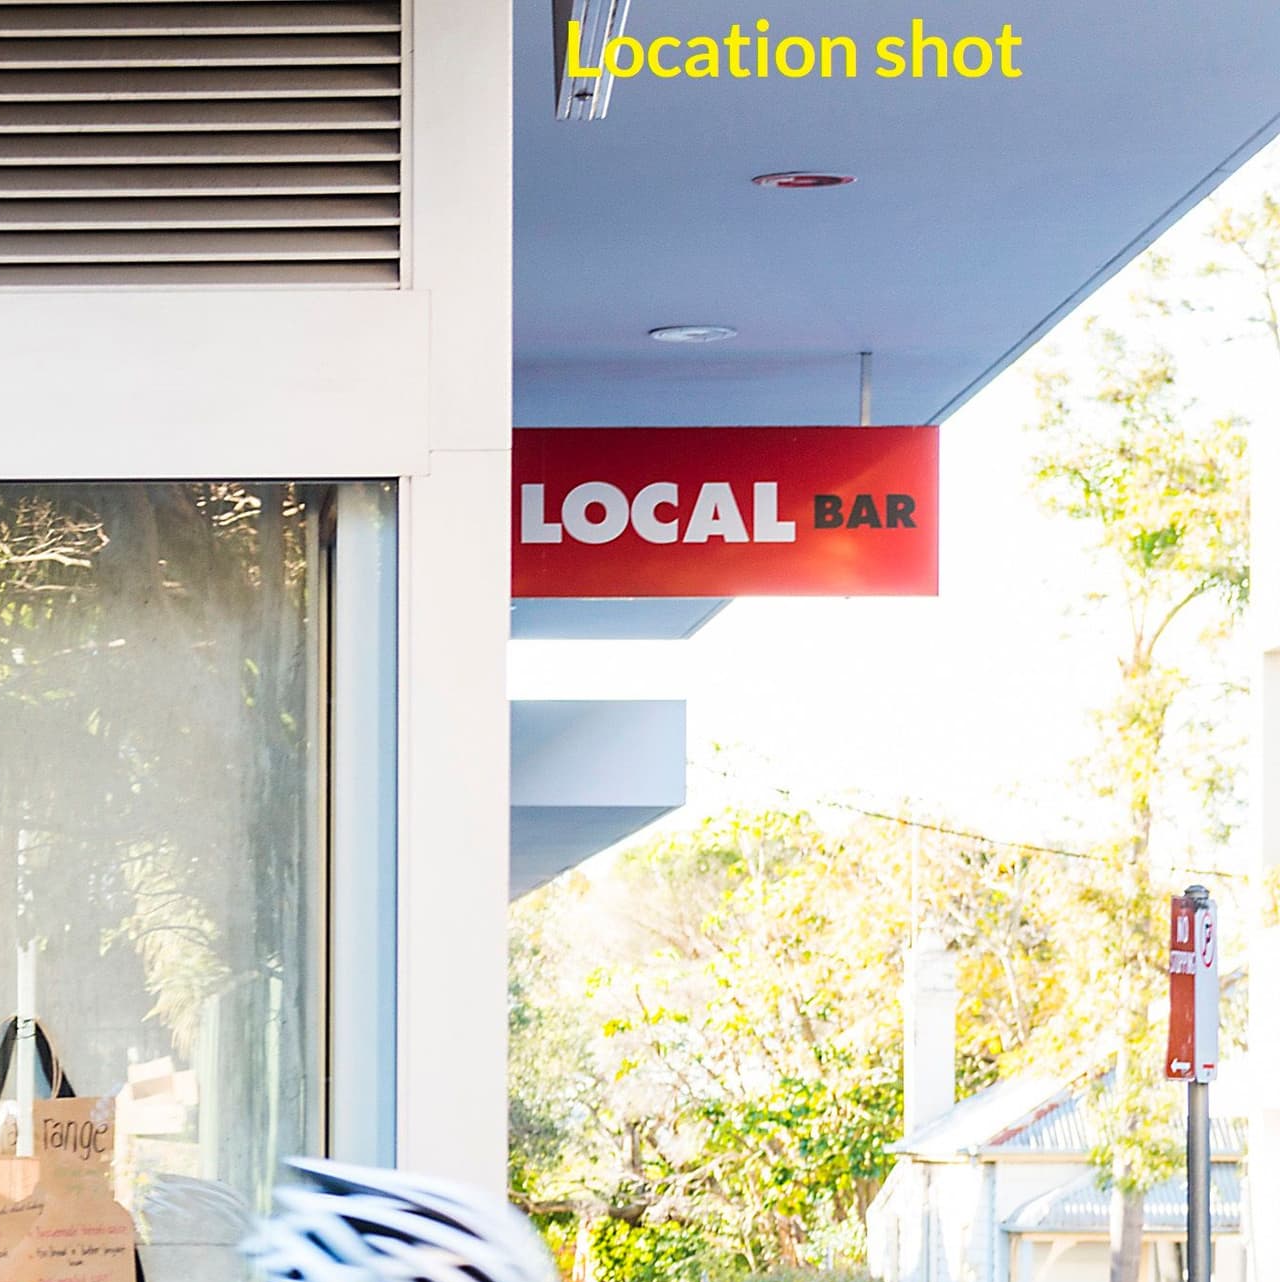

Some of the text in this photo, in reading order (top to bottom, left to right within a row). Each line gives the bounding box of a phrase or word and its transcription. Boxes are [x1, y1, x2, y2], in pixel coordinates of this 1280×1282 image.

[520, 481, 917, 545] LOCAL BAR
[42, 1117, 109, 1161] range
